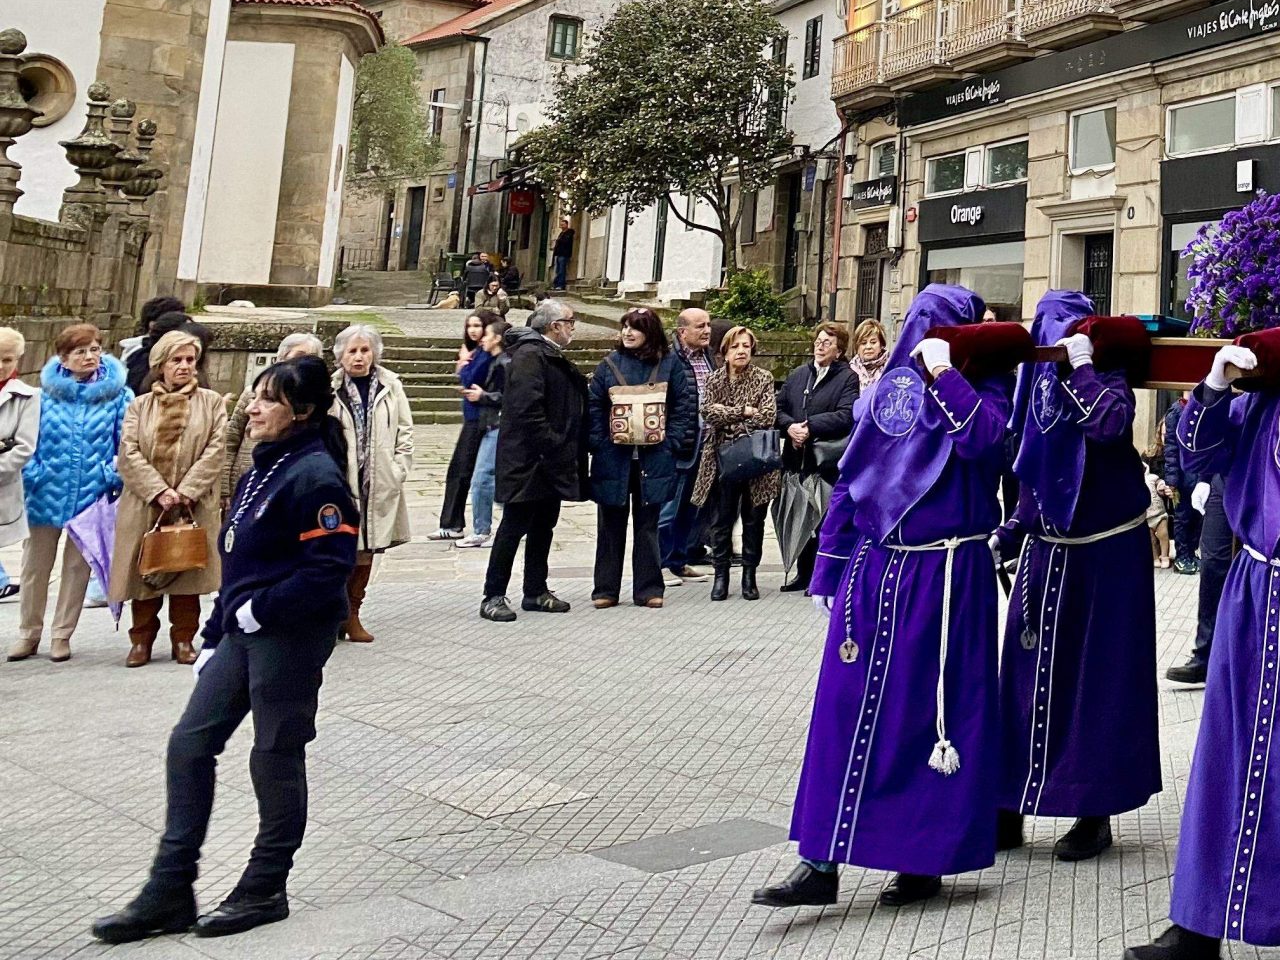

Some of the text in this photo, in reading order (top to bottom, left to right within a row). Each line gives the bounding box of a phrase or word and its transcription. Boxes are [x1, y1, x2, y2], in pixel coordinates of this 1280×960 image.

[1187, 20, 1218, 38] VIAJES
[1220, 12, 1228, 30] El
[1228, 9, 1248, 28] Corte
[1248, 0, 1280, 30] Inglés
[946, 92, 964, 106] VIAJES
[951, 205, 982, 225] Orange
